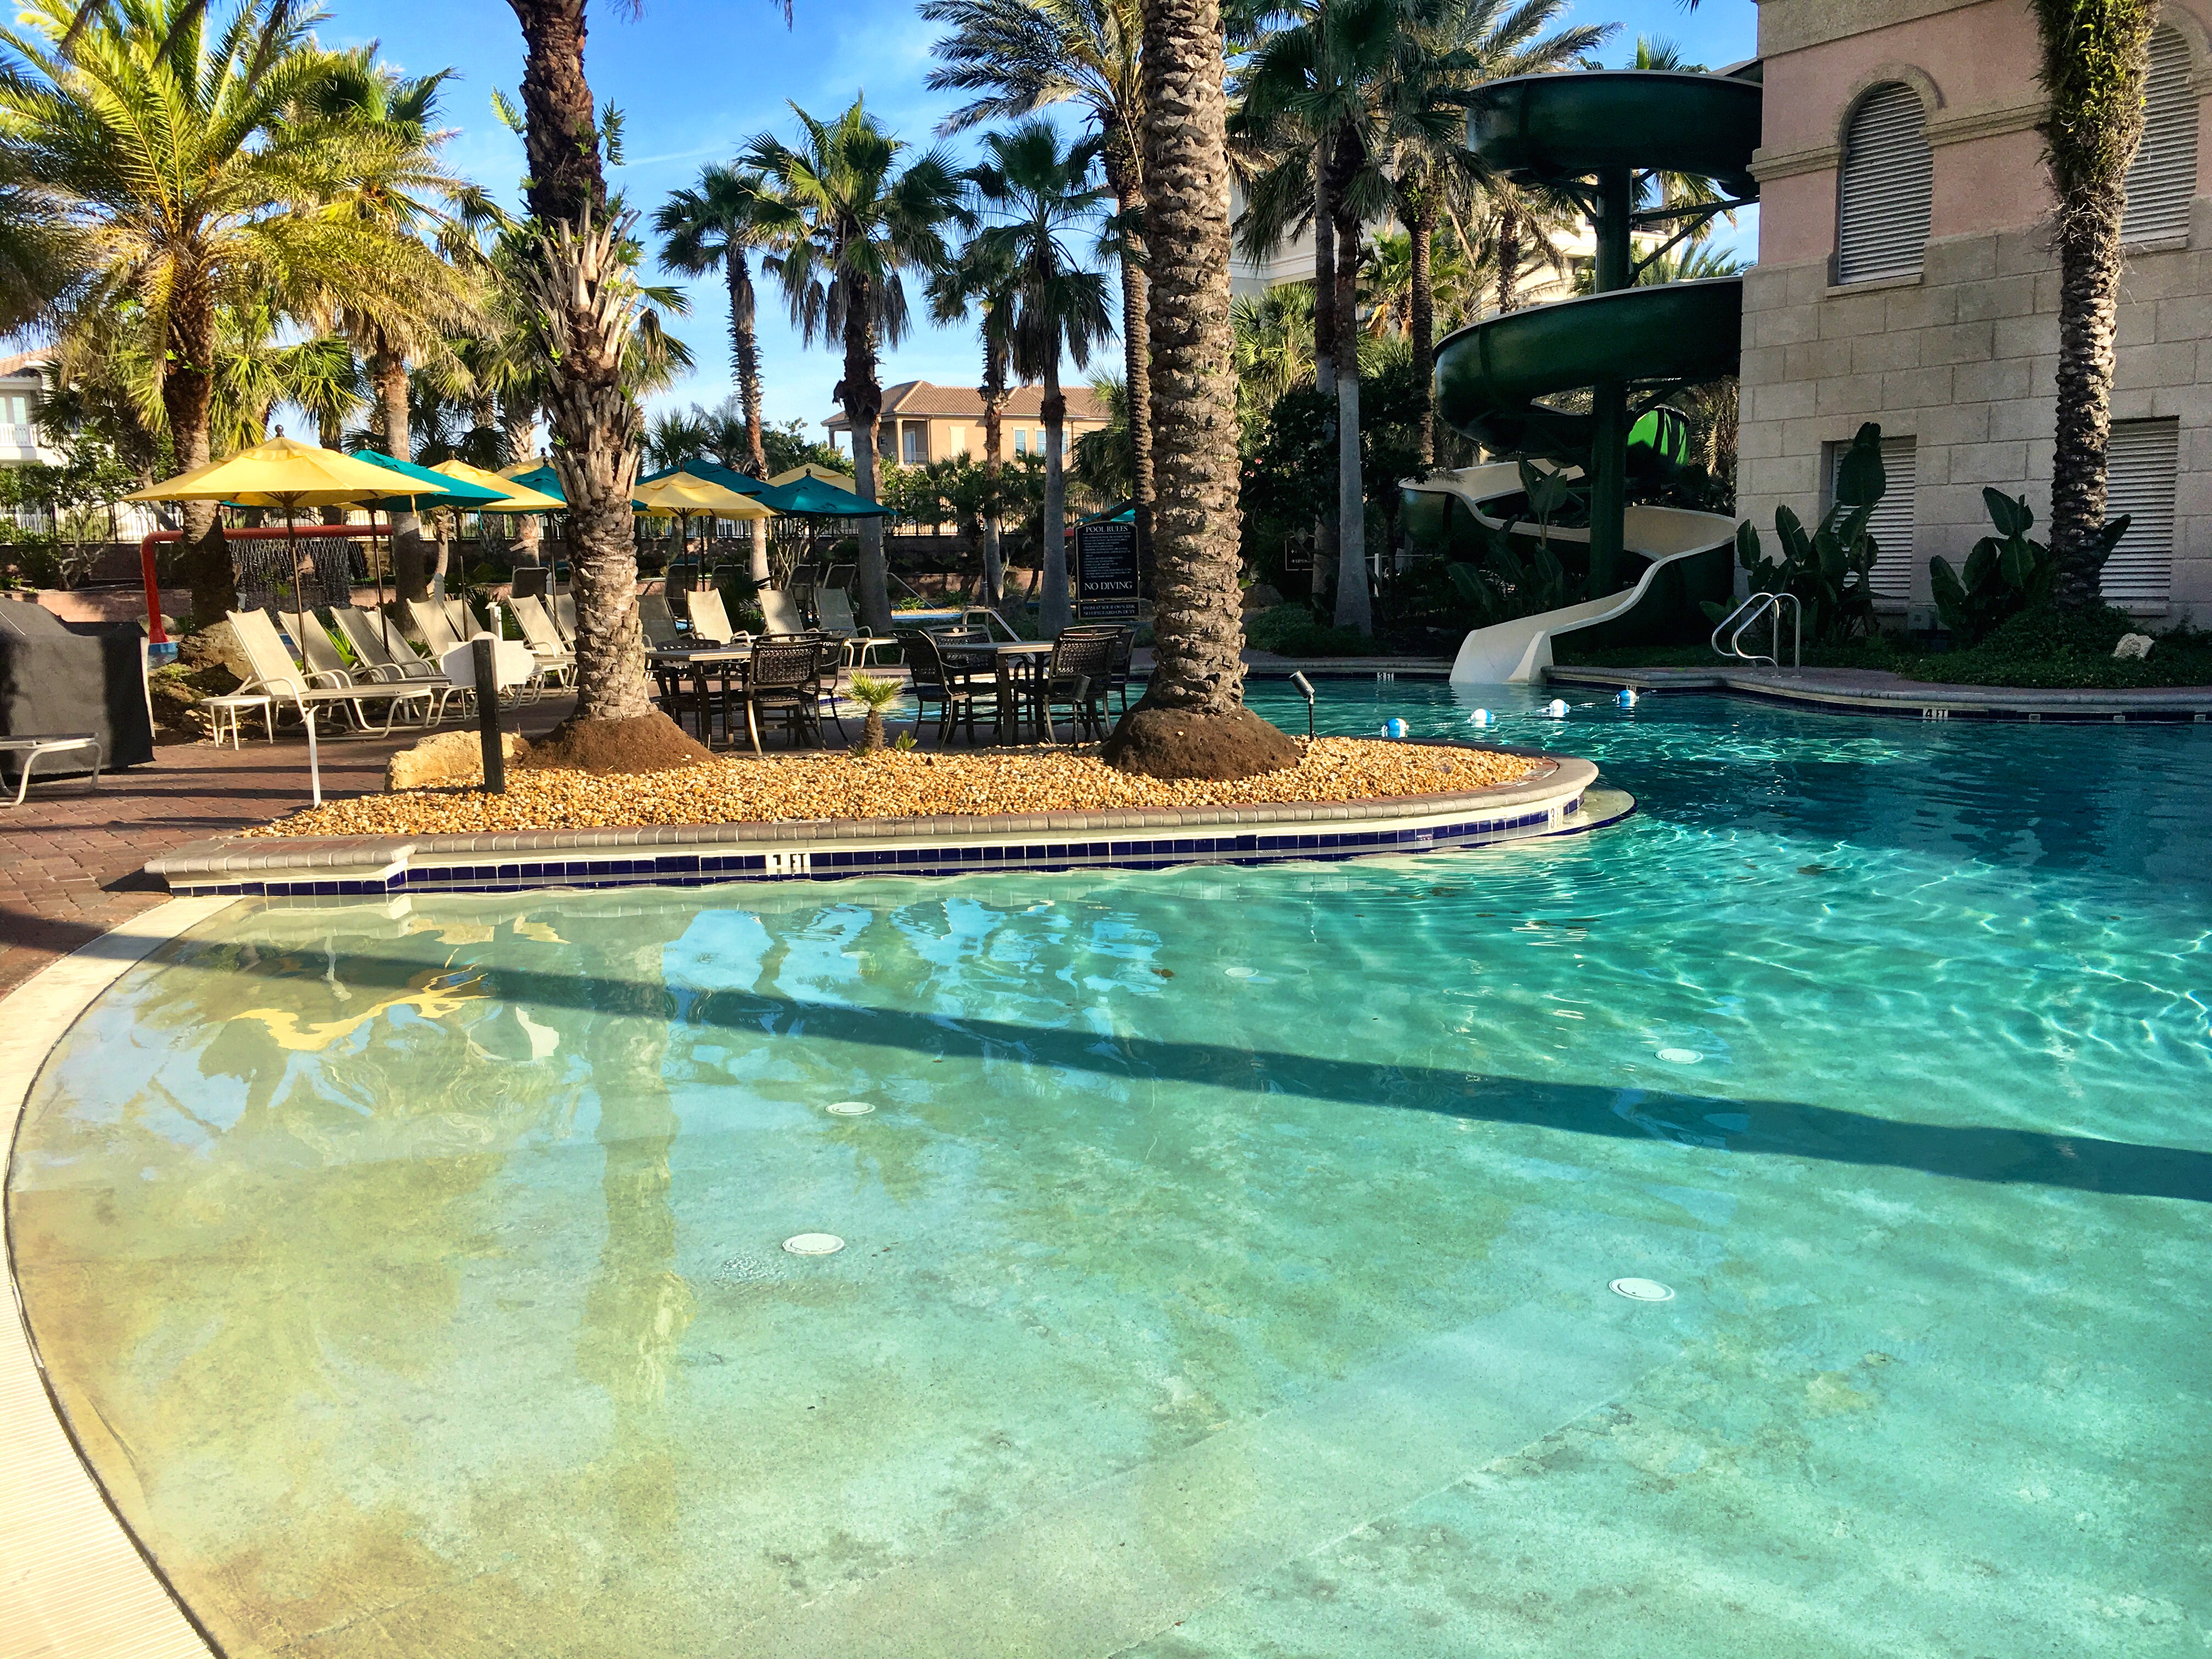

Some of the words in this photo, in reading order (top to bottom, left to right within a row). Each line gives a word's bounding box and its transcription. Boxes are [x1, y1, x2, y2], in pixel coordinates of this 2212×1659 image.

[1085, 582, 1098, 590] NO
[1101, 581, 1132, 590] DIVING
[1925, 708, 1933, 718] 4
[1936, 709, 1946, 718] FT
[773, 854, 781, 865] 1
[790, 853, 806, 868] FT
